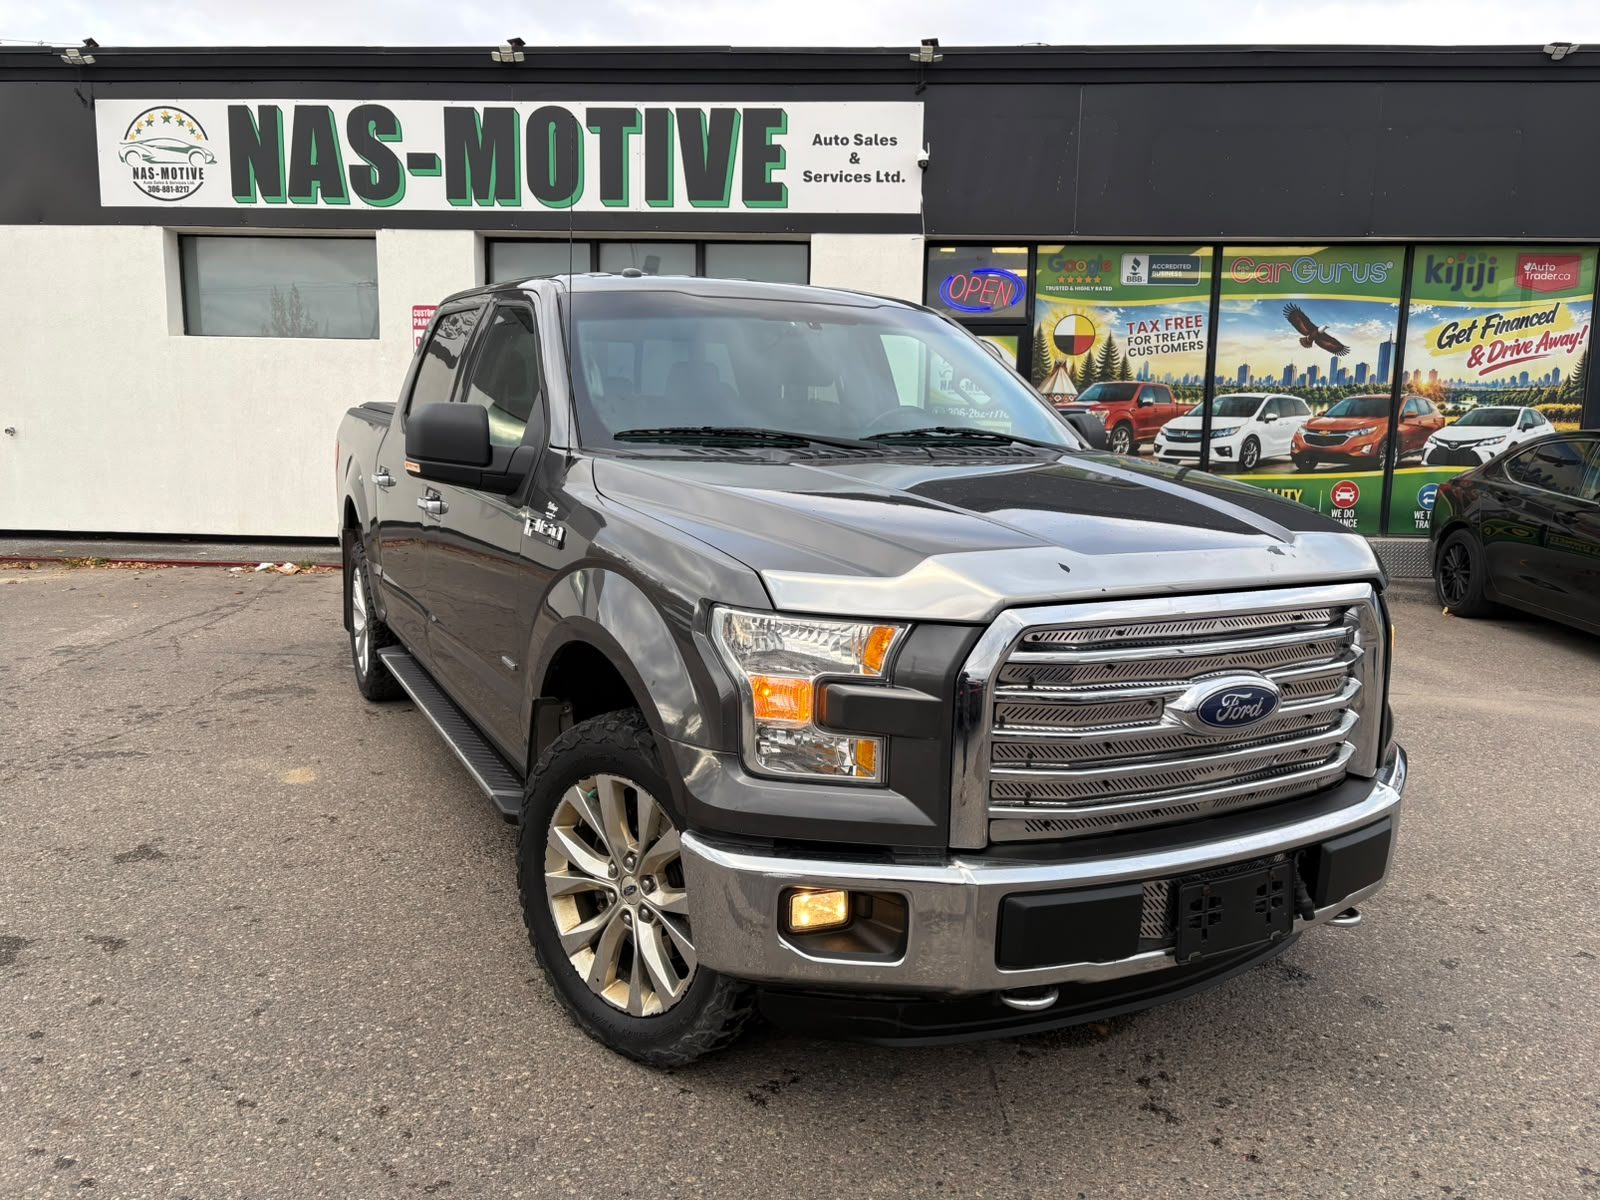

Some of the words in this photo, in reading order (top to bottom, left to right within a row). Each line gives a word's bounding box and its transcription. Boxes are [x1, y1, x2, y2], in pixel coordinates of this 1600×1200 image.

[812, 133, 850, 146] Auto
[853, 133, 898, 146] Sales
[227, 103, 788, 210] NAS-MOTIVE
[849, 152, 860, 165] &
[132, 167, 204, 180] NAS-MOTIVE
[802, 170, 872, 183] Services
[876, 170, 906, 183] Ltd.
[1047, 255, 1113, 276] Google
[1425, 253, 1497, 292] kijiji
[1530, 262, 1556, 271] Auto
[1525, 272, 1571, 280] Trader.ca
[949, 274, 1013, 305] OPEN
[1126, 319, 1160, 335] TAX
[1165, 315, 1203, 331] FREE
[1437, 319, 1478, 349] Get
[1480, 302, 1560, 340] Financed
[1127, 335, 1152, 346] FOR
[1154, 329, 1200, 344] TREATY
[1128, 340, 1204, 357] CUSTOMERS
[1467, 344, 1485, 368] &
[1486, 338, 1533, 364] Drive
[1534, 325, 1589, 354] Away!
[1331, 508, 1343, 518] WE
[1343, 509, 1355, 518] DO
[1413, 510, 1425, 520] WE
[1415, 520, 1431, 529] TRA
[1216, 692, 1265, 721] Ford
